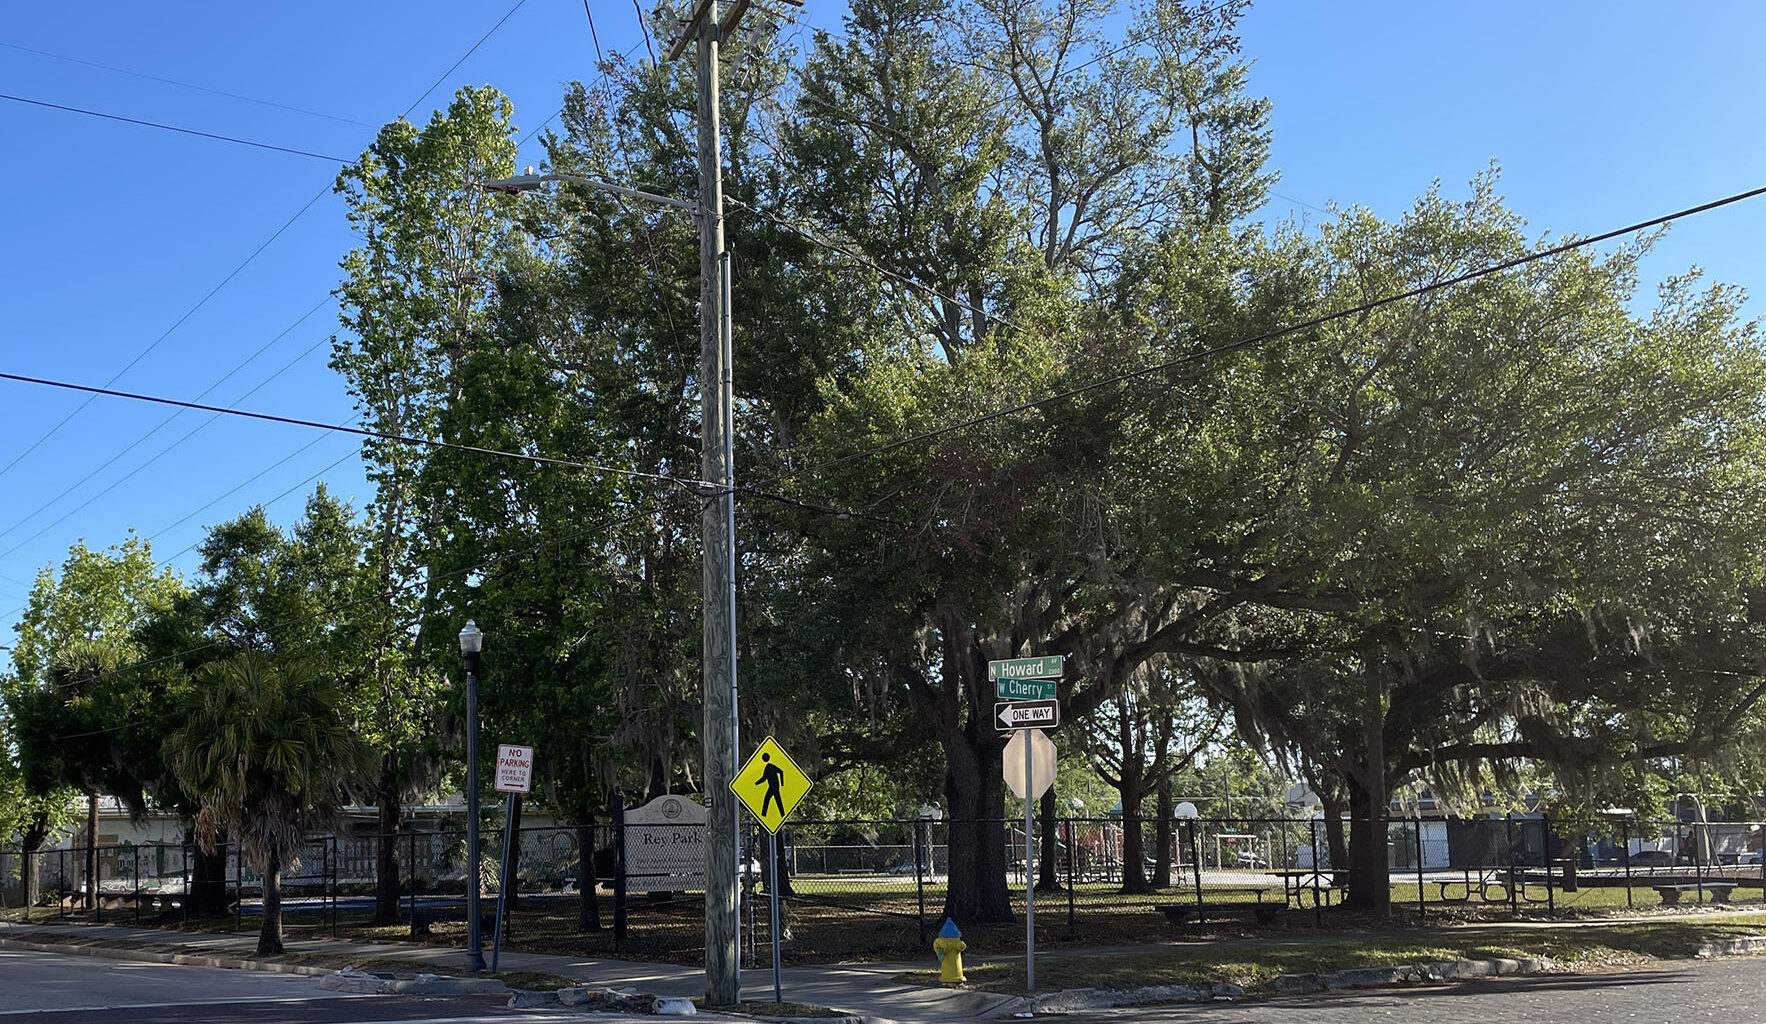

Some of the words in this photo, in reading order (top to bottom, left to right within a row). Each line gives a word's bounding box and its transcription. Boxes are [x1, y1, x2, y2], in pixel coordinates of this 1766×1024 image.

[990, 666, 996, 676] N
[1002, 660, 1043, 677] Howard
[999, 683, 1006, 694] W
[1009, 680, 1042, 699] Cherry
[1013, 710, 1029, 720] ONE
[1032, 708, 1050, 719] WAY
[509, 749, 522, 757] NO
[500, 758, 529, 768] PARKING
[672, 832, 702, 844] Park
